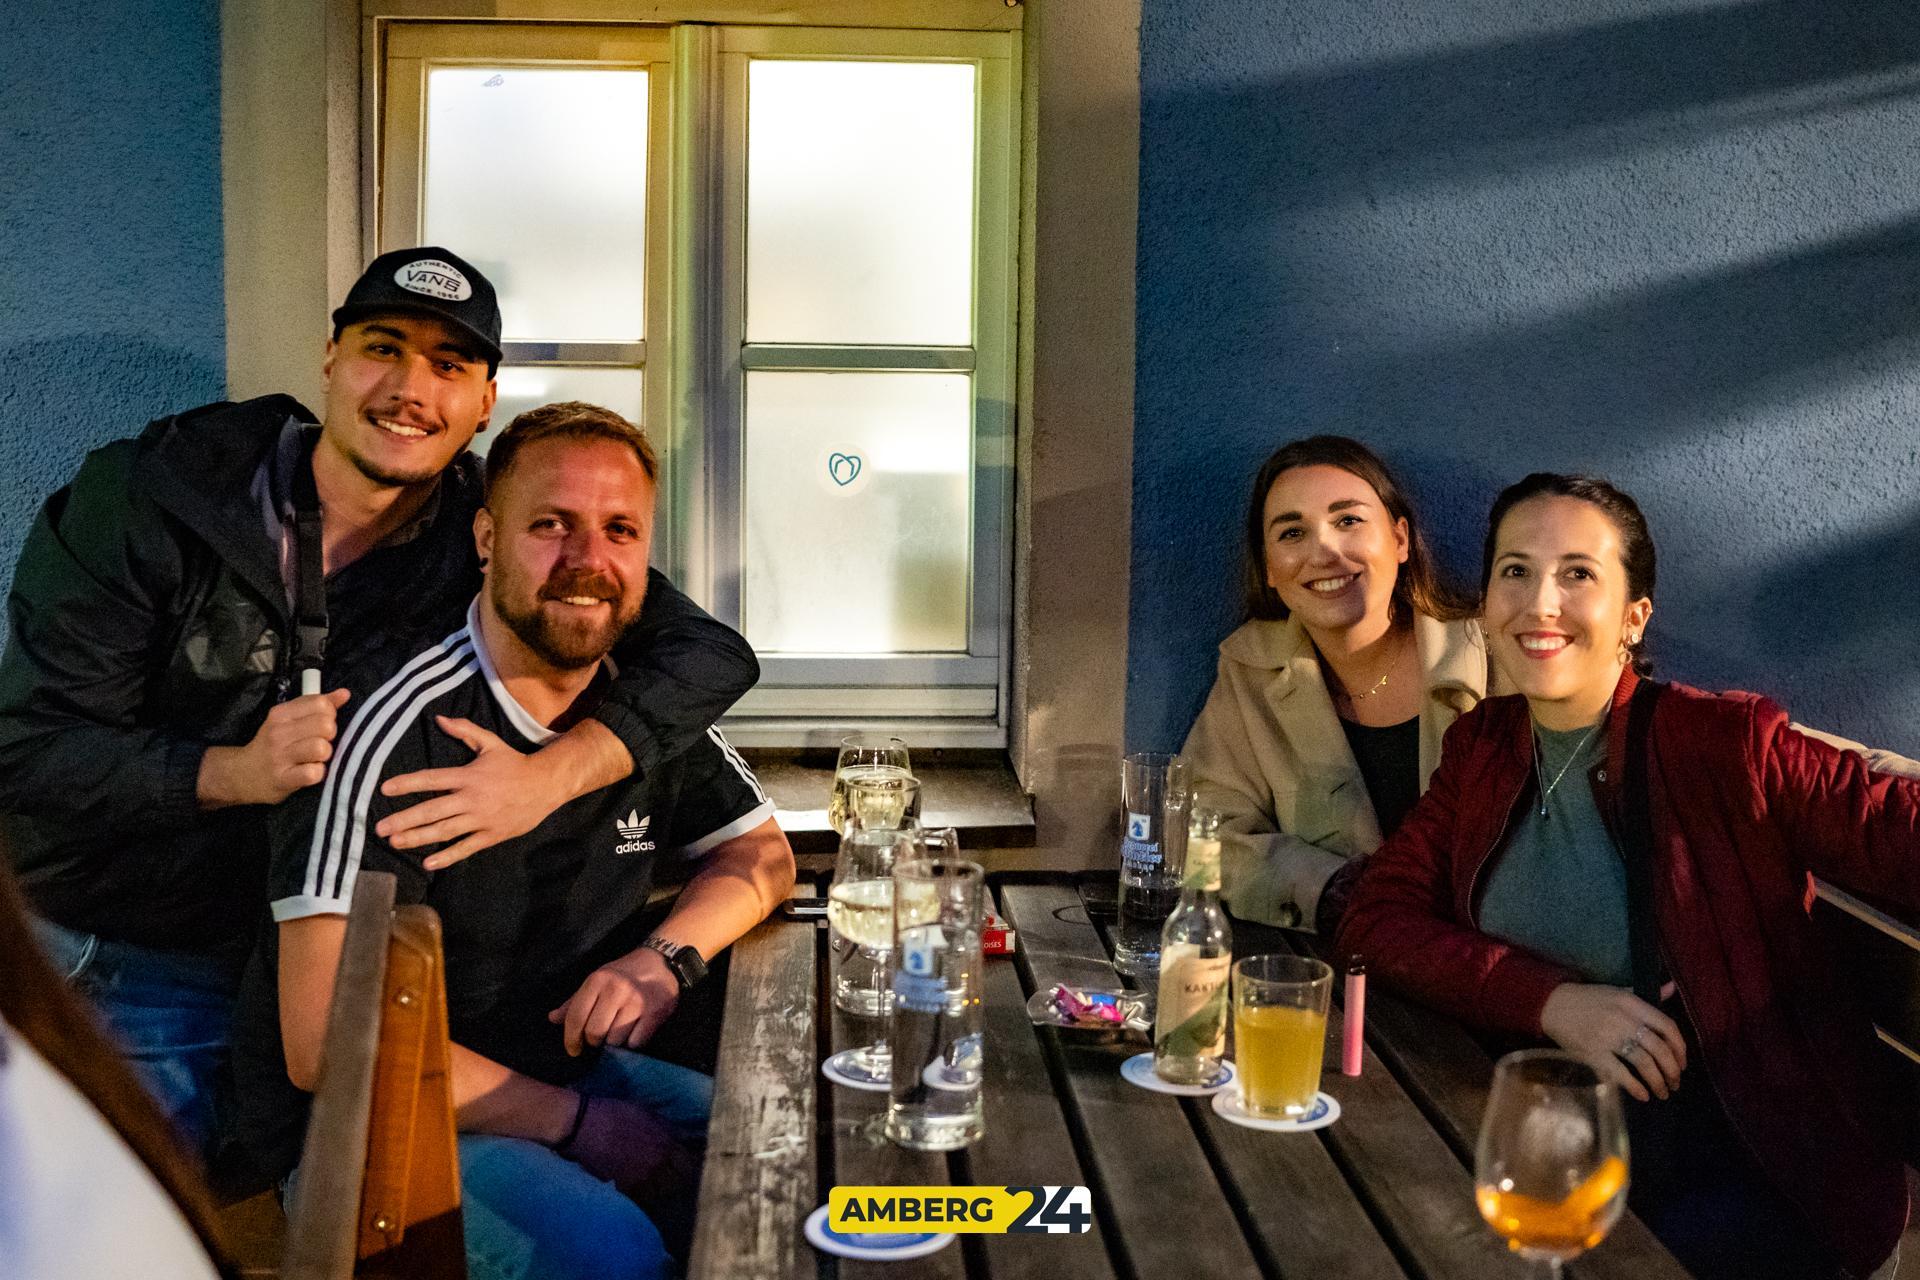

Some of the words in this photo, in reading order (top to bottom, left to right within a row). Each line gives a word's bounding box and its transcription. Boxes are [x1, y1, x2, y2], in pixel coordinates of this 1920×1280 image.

[409, 261, 462, 278] AUTHENTIC
[404, 283, 431, 294] SINCE
[407, 270, 461, 293] VANS
[615, 840, 656, 854] adidas
